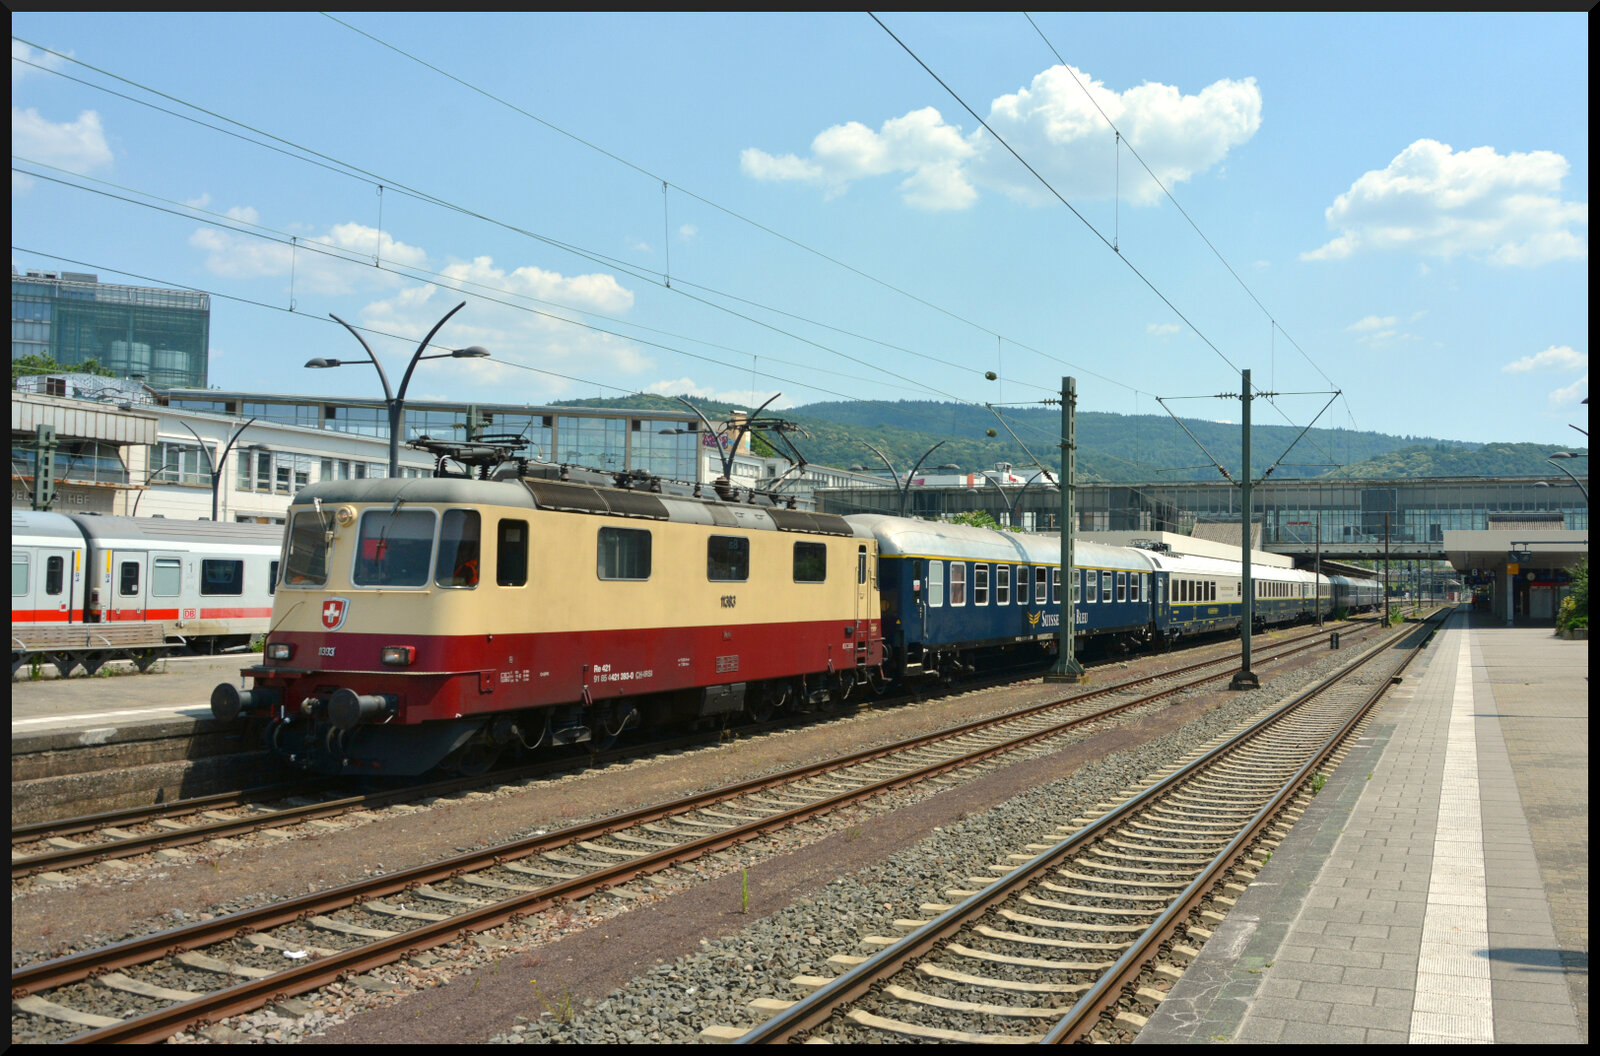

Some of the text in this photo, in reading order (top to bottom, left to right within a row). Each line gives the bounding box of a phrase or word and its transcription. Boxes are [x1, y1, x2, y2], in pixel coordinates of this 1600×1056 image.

[68, 494, 90, 505] HBF
[183, 609, 196, 618] DB
[593, 664, 611, 673] Re 421
